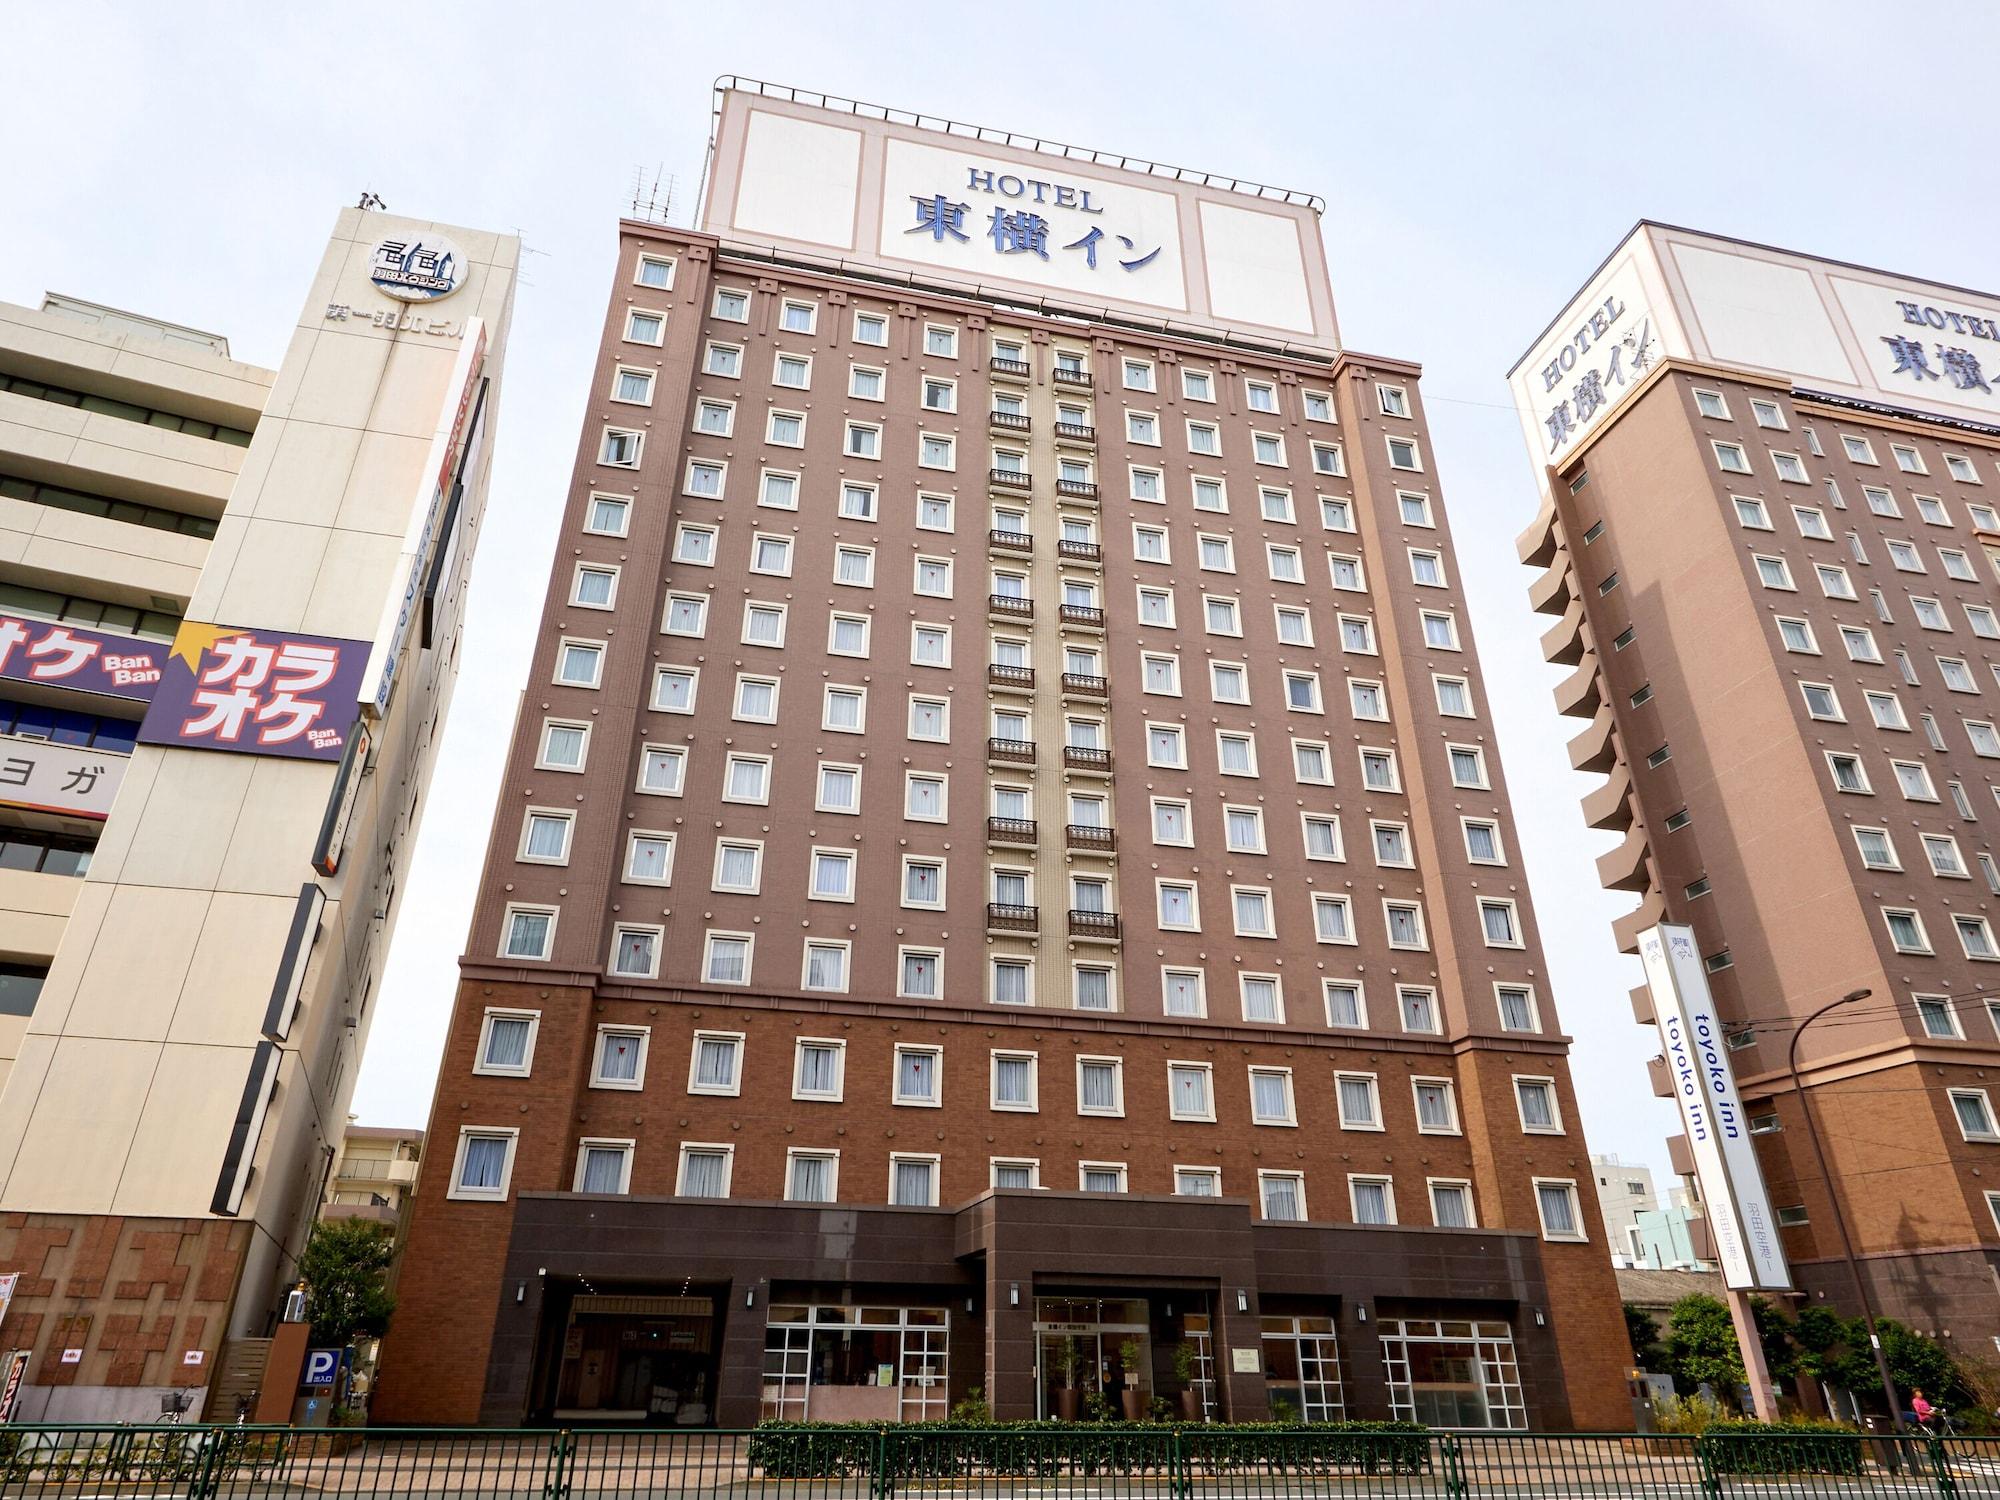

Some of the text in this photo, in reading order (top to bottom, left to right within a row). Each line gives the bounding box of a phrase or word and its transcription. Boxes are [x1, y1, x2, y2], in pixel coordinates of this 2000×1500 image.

[967, 167, 1103, 214] HOTEL
[904, 193, 1161, 272] 東横イン
[1541, 295, 1625, 393] HOTEL
[1545, 318, 1649, 454] 東横イン
[102, 654, 152, 672] Ban
[113, 668, 160, 686] Ban
[201, 638, 339, 692] カラ
[180, 687, 324, 743] オケ
[308, 727, 336, 741] Ban
[313, 736, 342, 749] Ban
[1667, 1015, 1707, 1141] toyoko inn
[1695, 1014, 1738, 1139] toyoko inn
